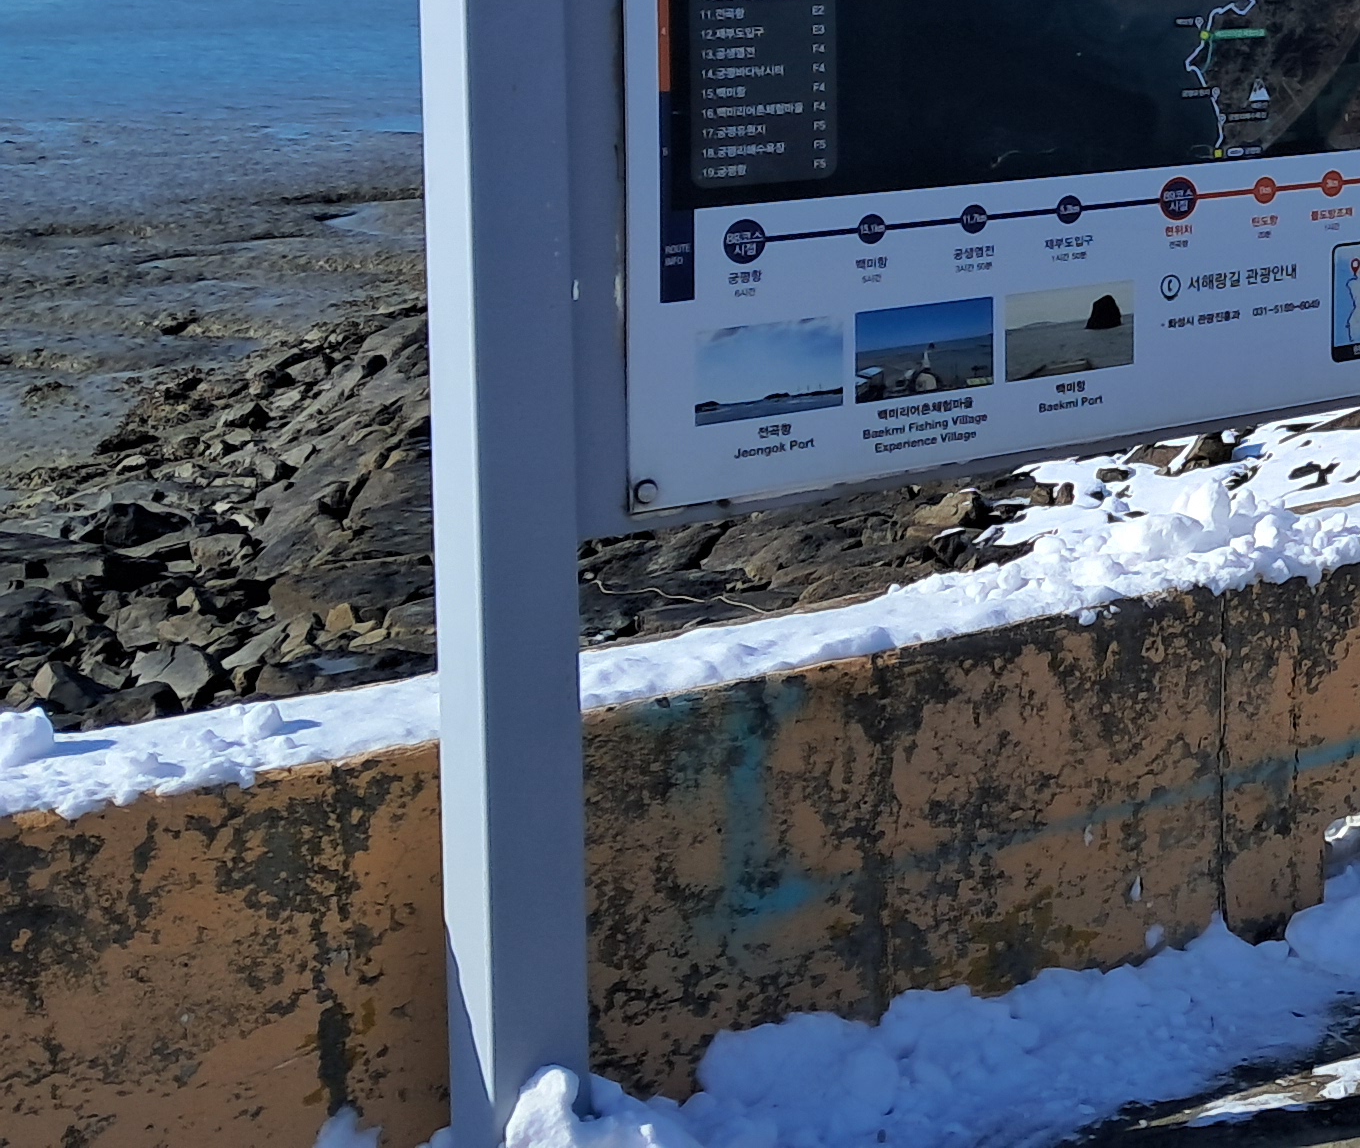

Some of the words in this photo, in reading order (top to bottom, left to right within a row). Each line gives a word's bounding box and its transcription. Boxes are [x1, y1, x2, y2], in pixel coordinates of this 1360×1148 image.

[812, 5, 825, 16] E2
[812, 24, 826, 35] E3
[812, 44, 826, 54] F4
[812, 63, 826, 73] F4
[813, 82, 826, 92] F4
[813, 102, 826, 112] F4
[813, 121, 827, 131] F5
[813, 139, 827, 150] F5
[813, 158, 827, 169] F5
[1163, 189, 1194, 200] 89코스
[1168, 199, 1189, 212] 시점
[1165, 224, 1193, 237] 현위치
[726, 230, 764, 245] 88코스
[1044, 234, 1094, 250] 제부도입구
[1168, 239, 1188, 249] 전곡항
[665, 243, 691, 254] ROUTE
[733, 242, 757, 256] 시점
[664, 256, 684, 267] INFO
[855, 255, 888, 270] 백미항
[728, 270, 763, 285] 궁평항
[1187, 270, 1241, 292] 서해랑길
[1245, 263, 1297, 286] 관광안내
[1168, 316, 1195, 329] 화성시
[1055, 380, 1086, 395] 백미항
[877, 397, 974, 420] 백미리어촌체험마을
[1038, 399, 1079, 414] Baekmi
[1081, 395, 1104, 408] Port
[757, 423, 792, 439] 전곡항
[862, 424, 906, 440] Baekmi
[908, 419, 949, 434] Fishing
[951, 413, 988, 429] Village
[874, 436, 938, 454] Experience
[940, 430, 977, 445] Village
[734, 442, 786, 460] Jeongok
[789, 438, 815, 451] Port
